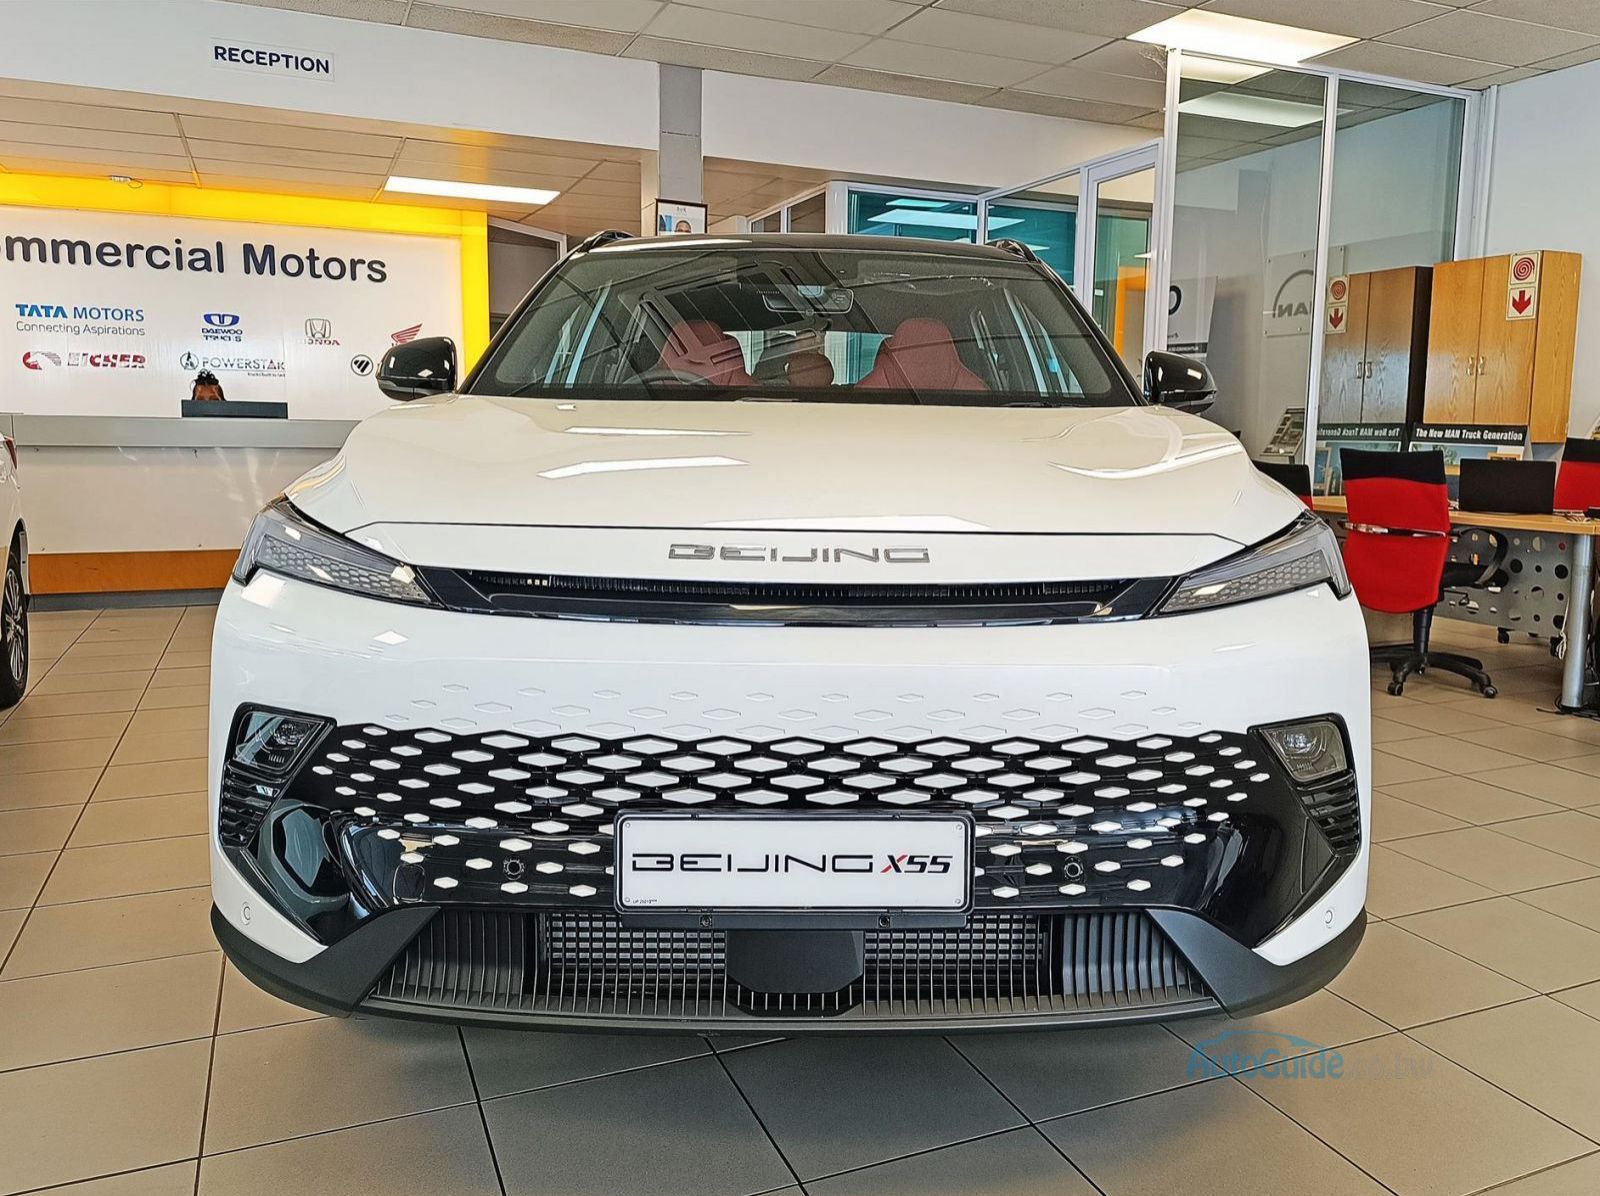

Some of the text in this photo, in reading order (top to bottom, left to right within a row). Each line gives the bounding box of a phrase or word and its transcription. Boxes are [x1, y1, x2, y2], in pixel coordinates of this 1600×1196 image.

[214, 45, 330, 74] RECEPTION
[0, 235, 387, 283] mmercial Motors
[15, 303, 145, 321] TATA MOTORS
[16, 321, 145, 336] Connecting Aspirations
[201, 327, 243, 335] DAEWOO
[1415, 428, 1523, 441] The New MAN Truck Generation
[668, 543, 931, 563] BEIJING
[632, 853, 953, 874] BEIJING X55
